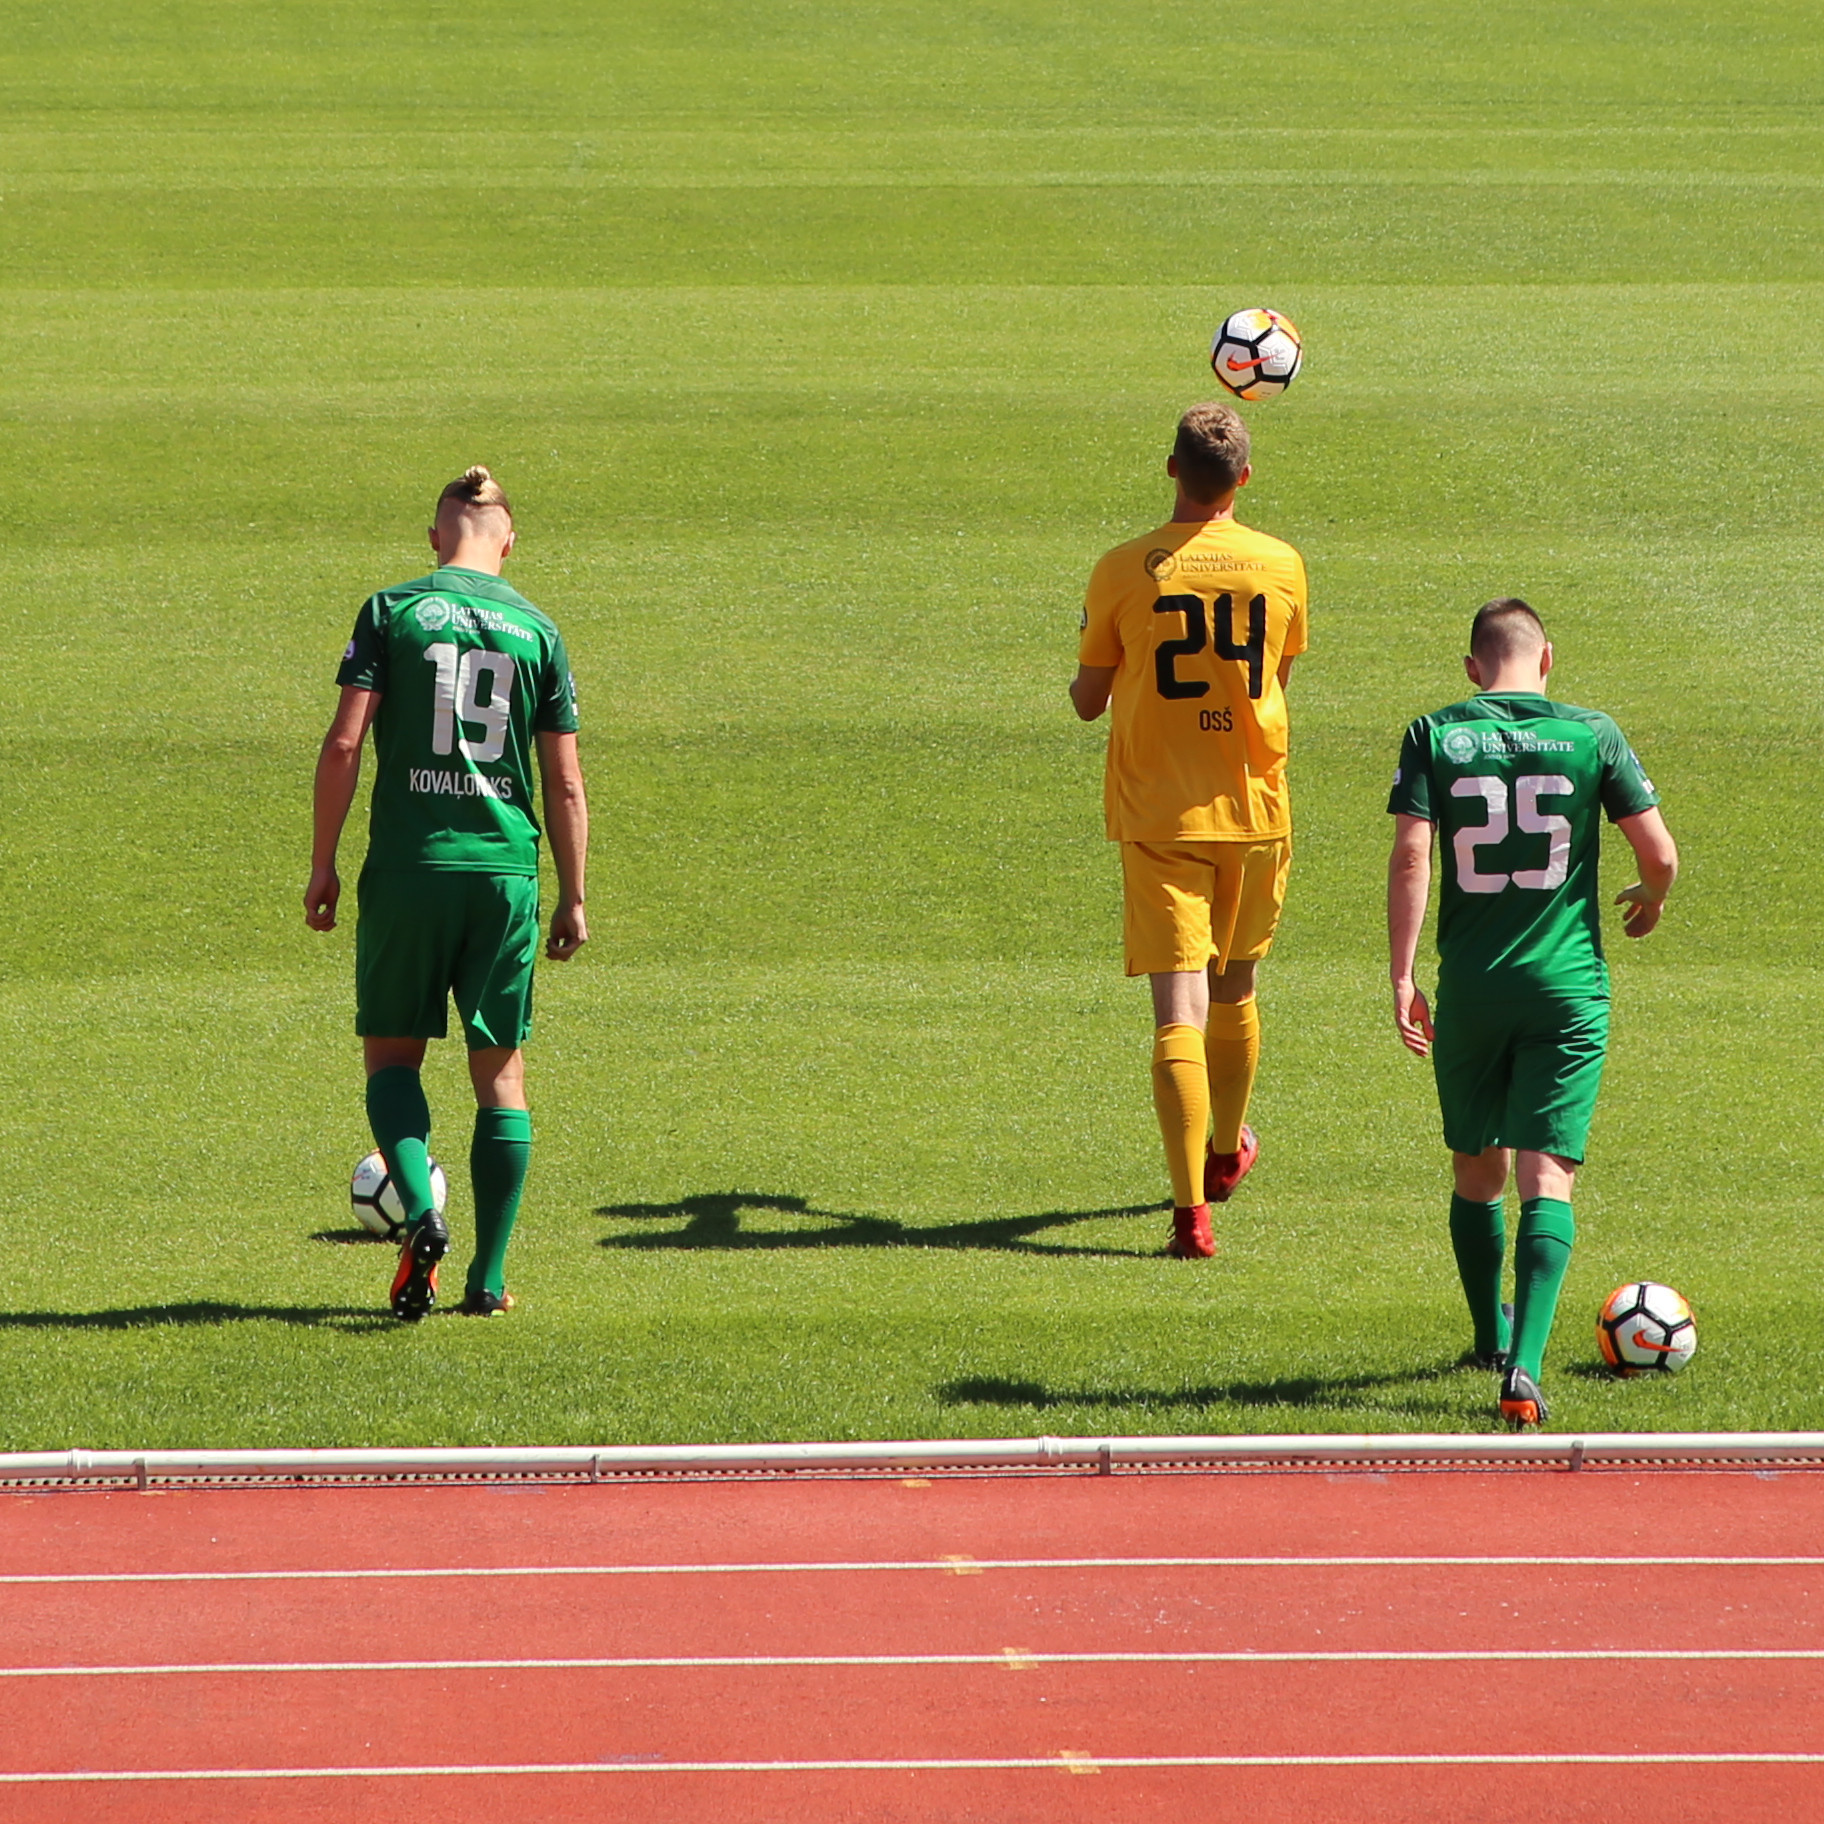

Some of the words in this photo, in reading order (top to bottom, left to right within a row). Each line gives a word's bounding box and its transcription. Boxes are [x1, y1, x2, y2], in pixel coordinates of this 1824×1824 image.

[424, 642, 516, 763] 19
[1153, 593, 1266, 700] 24
[1199, 706, 1233, 732] OSŠ
[1450, 775, 1574, 893] 25
